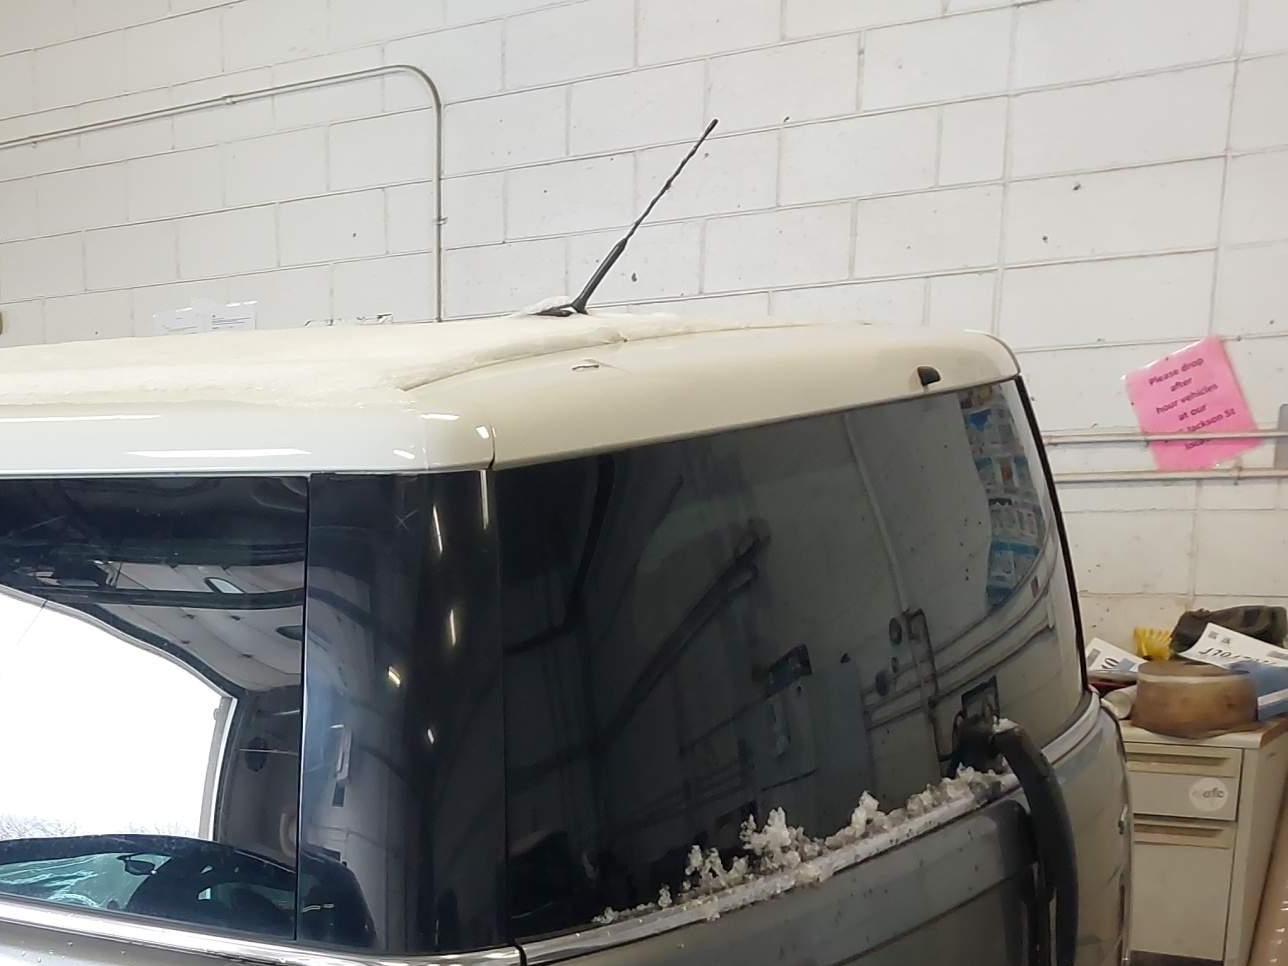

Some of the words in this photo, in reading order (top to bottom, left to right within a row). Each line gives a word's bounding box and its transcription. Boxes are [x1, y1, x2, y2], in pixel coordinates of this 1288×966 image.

[1148, 368, 1179, 386] Please
[1181, 357, 1205, 373] drop
[1170, 377, 1193, 392] after
[1155, 400, 1179, 415] hour
[1180, 383, 1219, 403] vehicles
[1178, 412, 1188, 422] at
[1190, 404, 1207, 416] our
